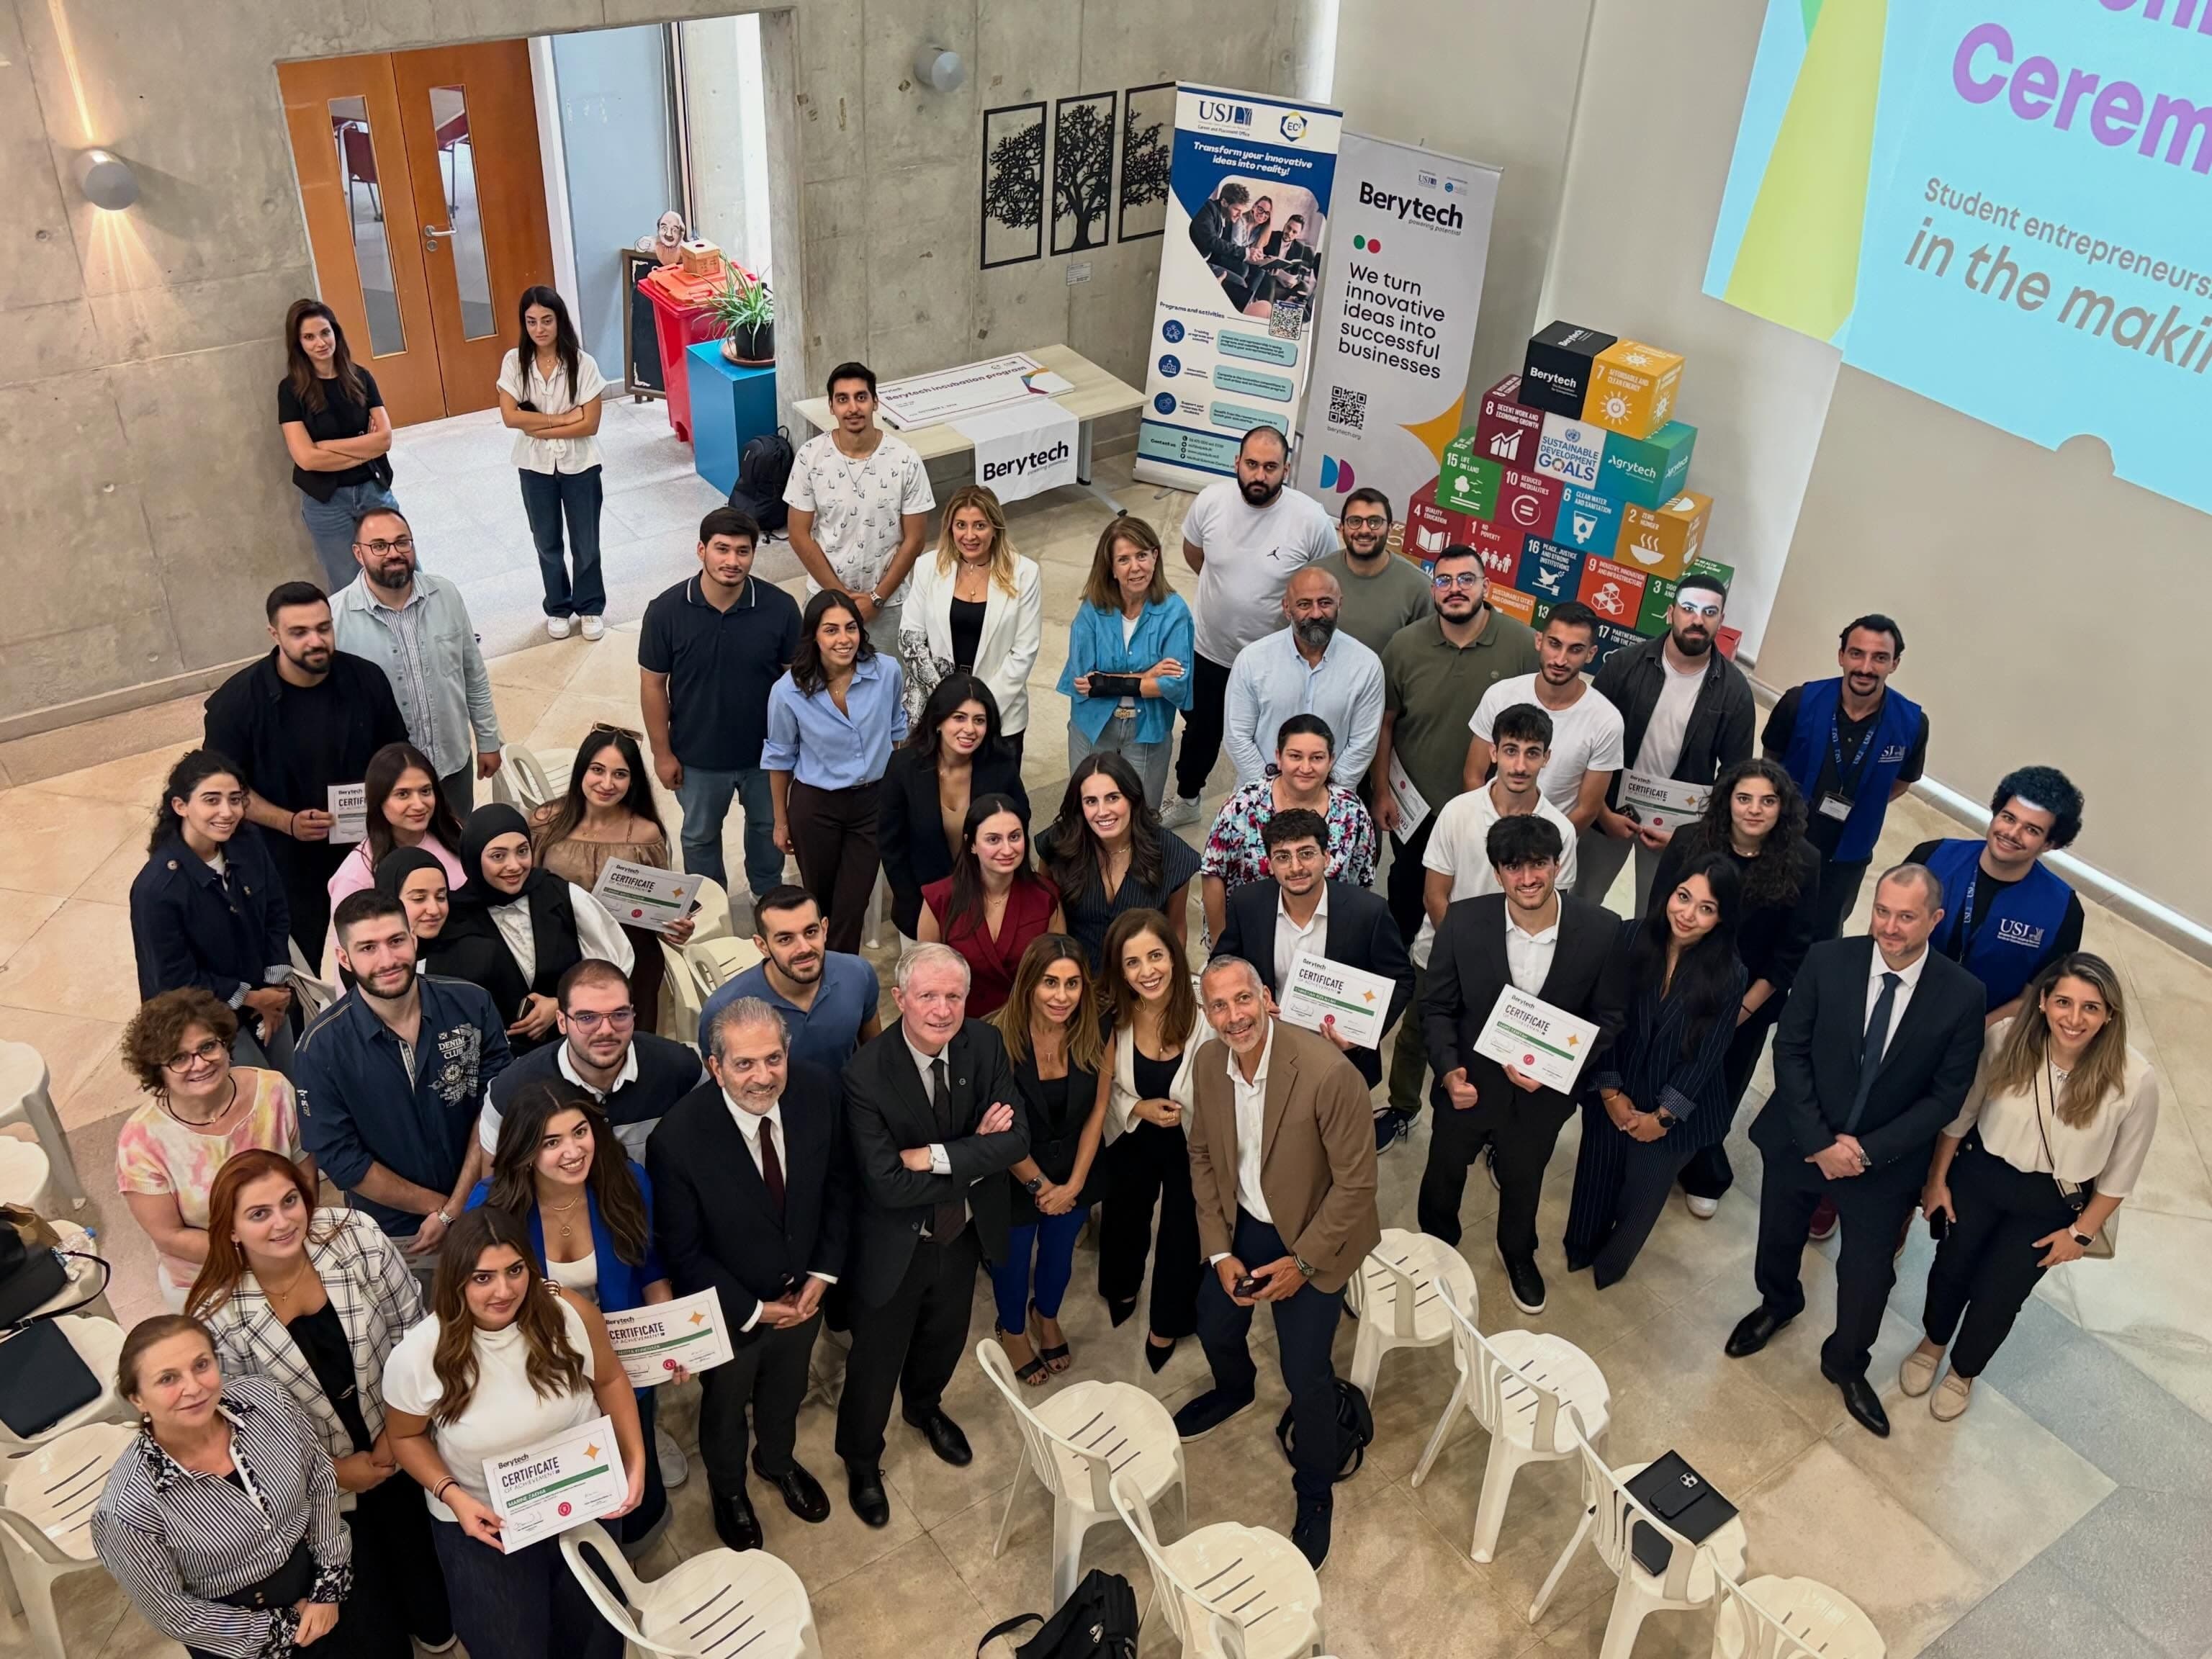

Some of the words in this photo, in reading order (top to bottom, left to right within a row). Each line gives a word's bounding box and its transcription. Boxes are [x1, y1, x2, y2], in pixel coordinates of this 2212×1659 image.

[1199, 100, 1235, 122] USJ
[1194, 141, 1242, 157] Transform
[1243, 150, 1264, 161] your
[1264, 153, 1313, 169] innovative
[1213, 154, 1237, 166] ideas
[1237, 159, 1255, 170] into
[1256, 162, 1290, 177] reality!
[1359, 181, 1463, 230] Berytech
[1924, 177, 2020, 230] Student
[1408, 218, 1434, 230] powering
[1434, 224, 1462, 236] potential
[1905, 217, 1955, 276] in
[1964, 243, 2050, 311] the
[1349, 262, 1378, 284] We
[1383, 273, 1421, 297] turn
[1346, 281, 1445, 322] innovative
[1159, 301, 1187, 313] Programs
[1198, 309, 1225, 319] activities
[1344, 300, 1395, 328] ideas
[1400, 315, 1436, 339] into
[1340, 322, 1440, 360] successful
[1557, 329, 1584, 347] Berytech
[1338, 337, 1441, 379] businesses
[1530, 367, 1577, 389] Berytech
[1596, 364, 1605, 379] 7
[886, 388, 931, 401] Berytech
[986, 365, 1027, 379] program
[1607, 376, 1622, 387] CLEAN
[1622, 379, 1642, 392] ENERGY
[1638, 376, 1650, 387] AND
[1485, 400, 1495, 415] 8
[1497, 403, 1514, 415] DECENT
[1514, 408, 1529, 418] WORK
[1528, 412, 1539, 421] AND
[1496, 411, 1519, 424] ECONOMIC
[1519, 417, 1539, 430] GROWTH
[1326, 426, 1362, 441] berytech.org
[1150, 439, 1170, 447] Contact
[1542, 436, 1599, 460] SUSTAINABLE
[984, 441, 1069, 482] Berytech
[1446, 452, 1457, 467] 15
[1460, 456, 1471, 464] LIFE
[1540, 445, 1598, 467] DEVELOPMENT
[1468, 464, 1480, 474] LAND
[1538, 453, 1596, 482] GOALS
[1607, 454, 1656, 480] Agrytech
[1506, 471, 1519, 486] 10
[1520, 474, 1542, 486] REDUCED
[1519, 481, 1550, 496] INEQUALITIES
[1563, 487, 1571, 502] 6
[1575, 490, 1591, 501] CLEAN
[1591, 495, 1608, 506] WATER
[1413, 503, 1421, 517] 4
[1425, 505, 1444, 517] QUALITY
[1575, 498, 1585, 509] AND
[1584, 500, 1612, 515] SANITATION
[1424, 513, 1447, 525] EDUCATION
[1628, 508, 1637, 523] 2
[1641, 512, 1655, 521] ZERO
[1471, 521, 1478, 534] 1
[1640, 519, 1660, 531] HUNGER
[1480, 529, 1501, 542] POVERTY
[1527, 539, 1540, 554] 16
[1542, 543, 1559, 554] PEACE,
[1559, 549, 1578, 560] JUSTICE
[1539, 557, 1570, 572] INSTITUTIONS
[1541, 550, 1551, 560] AND
[1550, 553, 1570, 564] STRONG
[1588, 558, 1597, 572] 9
[1598, 567, 1607, 576] AND
[1607, 570, 1643, 588] INFRASTRUCTURE
[1620, 566, 1646, 581] INNOVATION
[1653, 580, 1661, 594] 3
[1665, 583, 1677, 592] GOO
[1538, 604, 1550, 620] 13
[1599, 624, 1611, 639] 17
[1610, 635, 1620, 644] FOR
[1628, 783, 1668, 799] CERTIFICATE
[616, 863, 639, 874] Berytech
[611, 873, 656, 890] CERTIFICATE
[2000, 918, 2031, 938] USJ
[1303, 958, 1326, 971] Berytech
[1298, 968, 1344, 991] CERTIFICATE
[1511, 994, 1535, 1010] Berytech
[1504, 1004, 1551, 1032] CERTIFICATE
[437, 1036, 466, 1051] DENIM
[443, 1048, 464, 1060] CLUB
[606, 1316, 635, 1325] Berytech
[608, 1321, 665, 1341] CERTIFICATE
[498, 1453, 529, 1470] Berytech
[501, 1456, 560, 1488] CERTIFICATE
[513, 1471, 555, 1491] ACHIEVEMENT
[507, 1496, 528, 1507] MARINE
